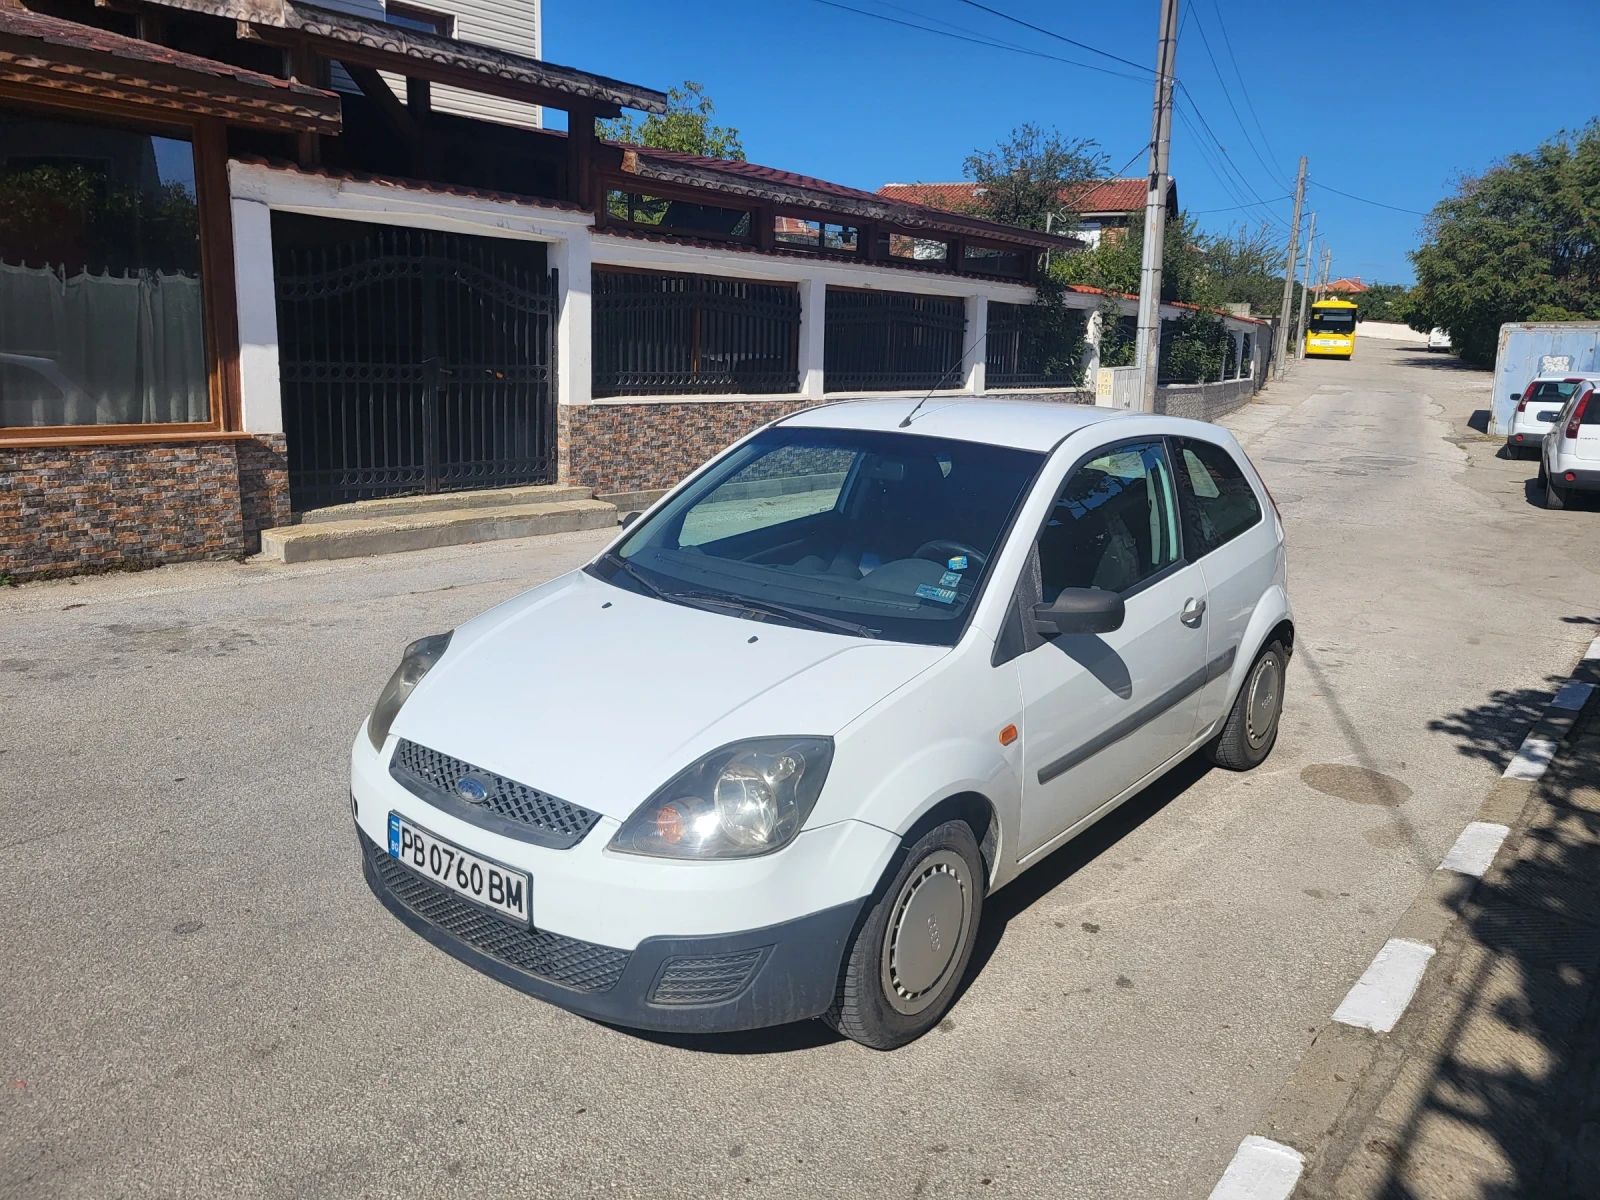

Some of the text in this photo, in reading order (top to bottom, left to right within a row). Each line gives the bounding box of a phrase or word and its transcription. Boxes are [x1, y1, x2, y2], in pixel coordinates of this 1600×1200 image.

[391, 840, 399, 852] BG
[402, 827, 523, 913] PB 0760 BM
